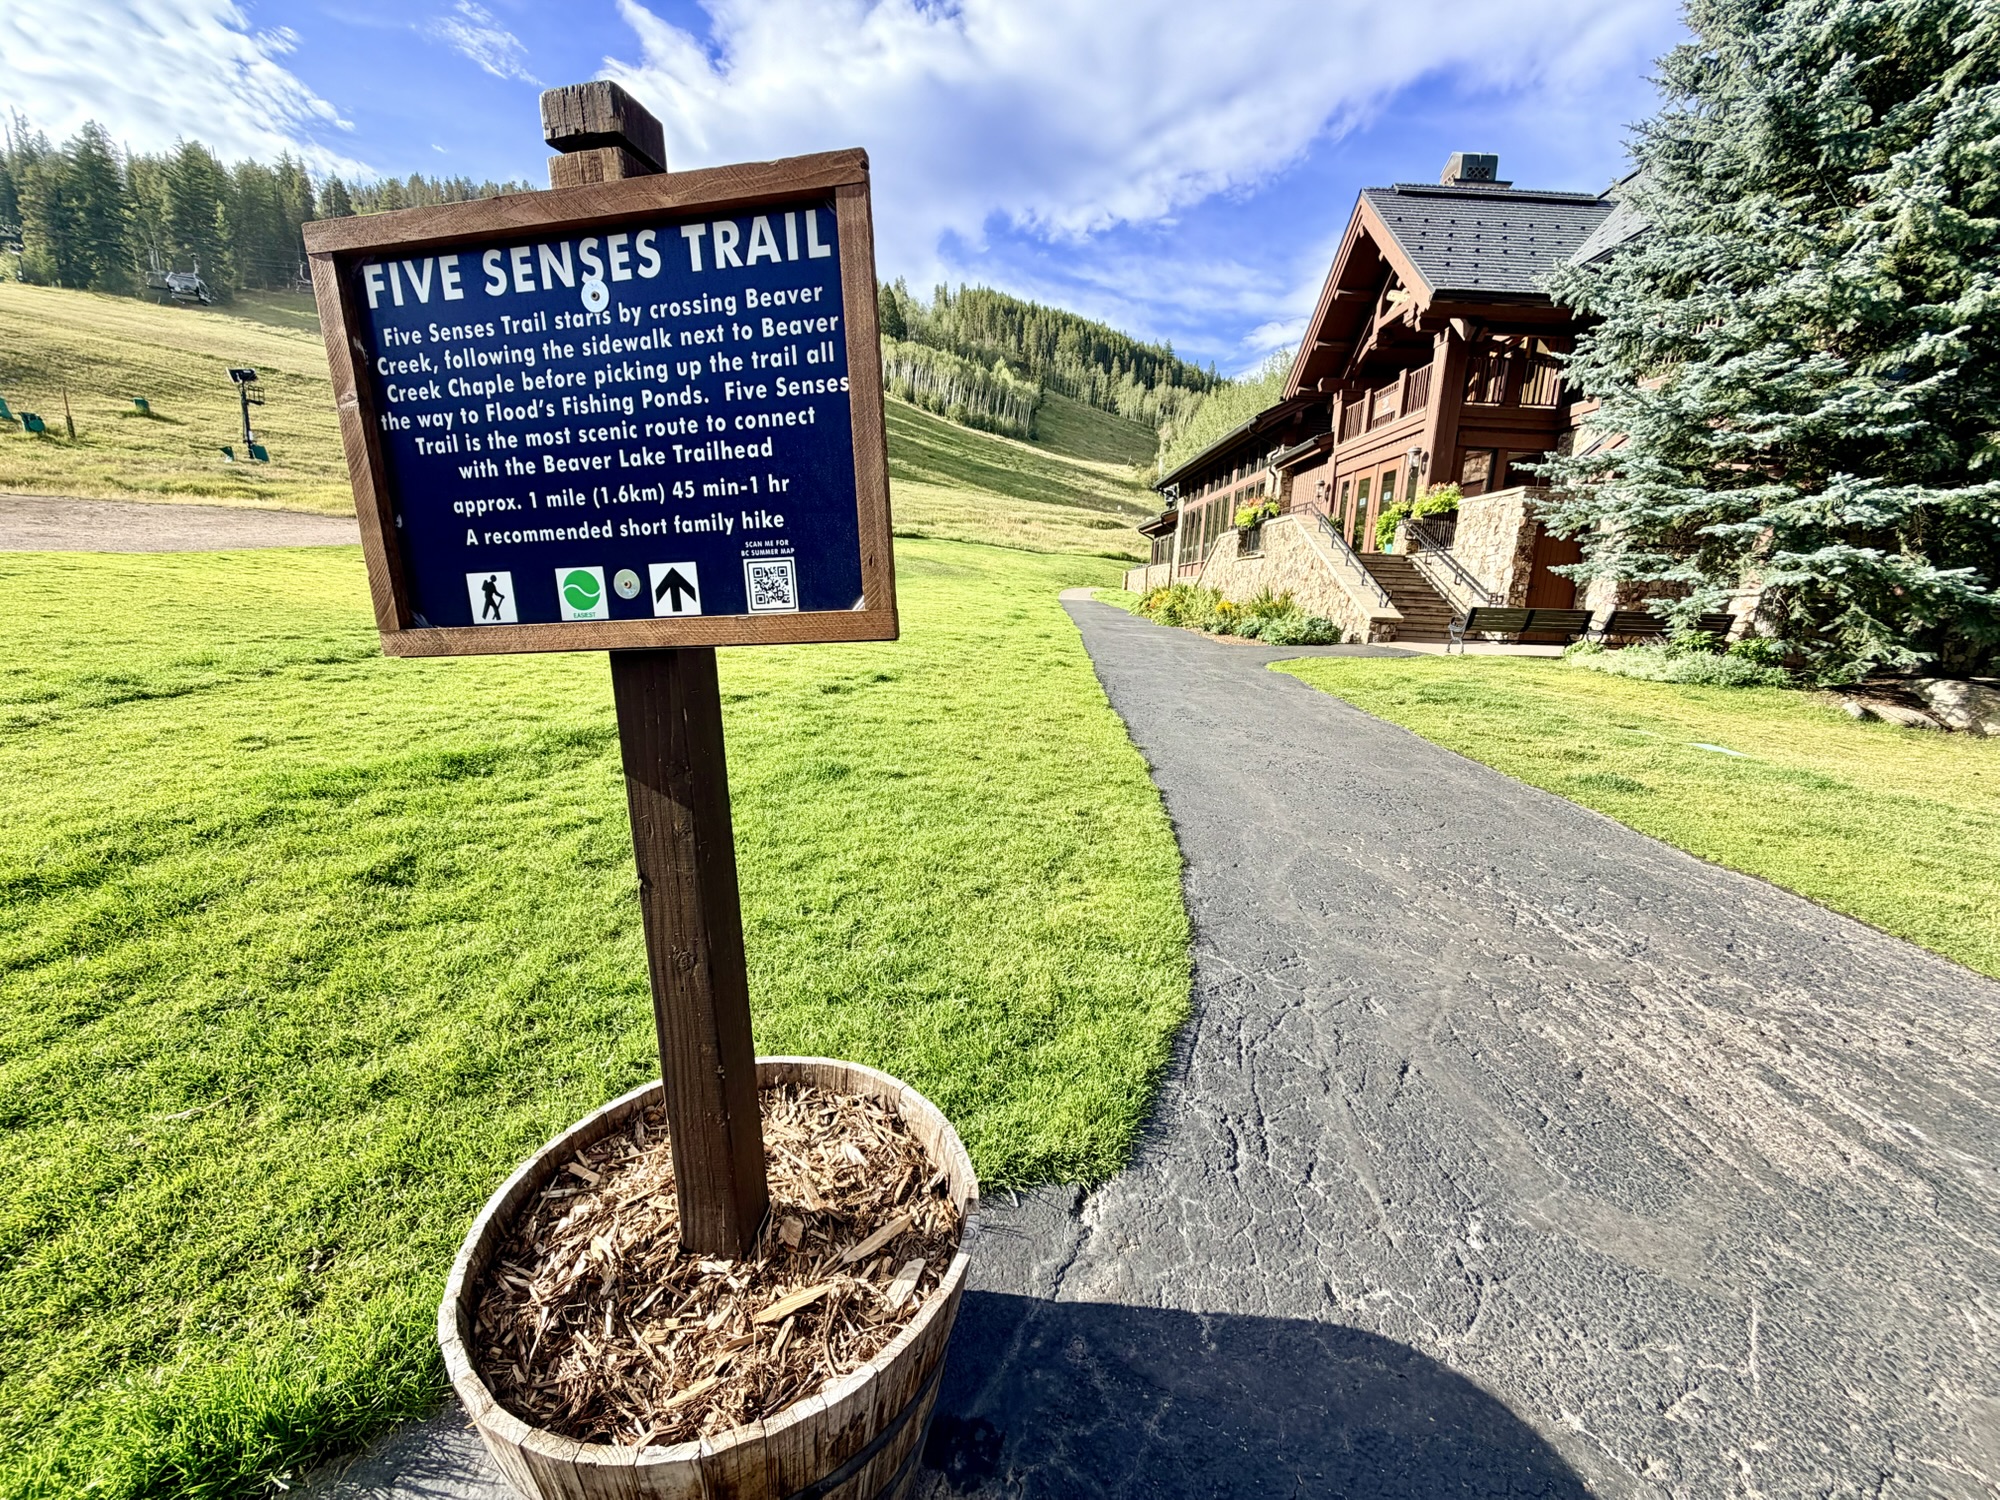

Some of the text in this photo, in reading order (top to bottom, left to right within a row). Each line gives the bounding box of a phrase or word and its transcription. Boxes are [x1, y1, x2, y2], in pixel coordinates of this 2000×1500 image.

[363, 209, 831, 309] FIVE SENSES TRAIL
[383, 286, 823, 347] Five Senses Trail starts by crossing Beaver
[377, 315, 839, 376] Creek, following the sidewalk next to Beaver
[387, 340, 834, 403] Creek Chaple before picking up the trail all
[381, 376, 850, 431] the way to Flood's Fishing Ponds. Five Senses
[414, 406, 816, 455] Trail is the most scenic route to connect
[458, 436, 773, 479] with the Beaver Lake Trailhead
[453, 473, 790, 518] approx. 1 mile (1.6km) 45 min-1 hr
[466, 509, 785, 546] A recommended short family hike
[741, 547, 795, 557] BC SUMMER MAP
